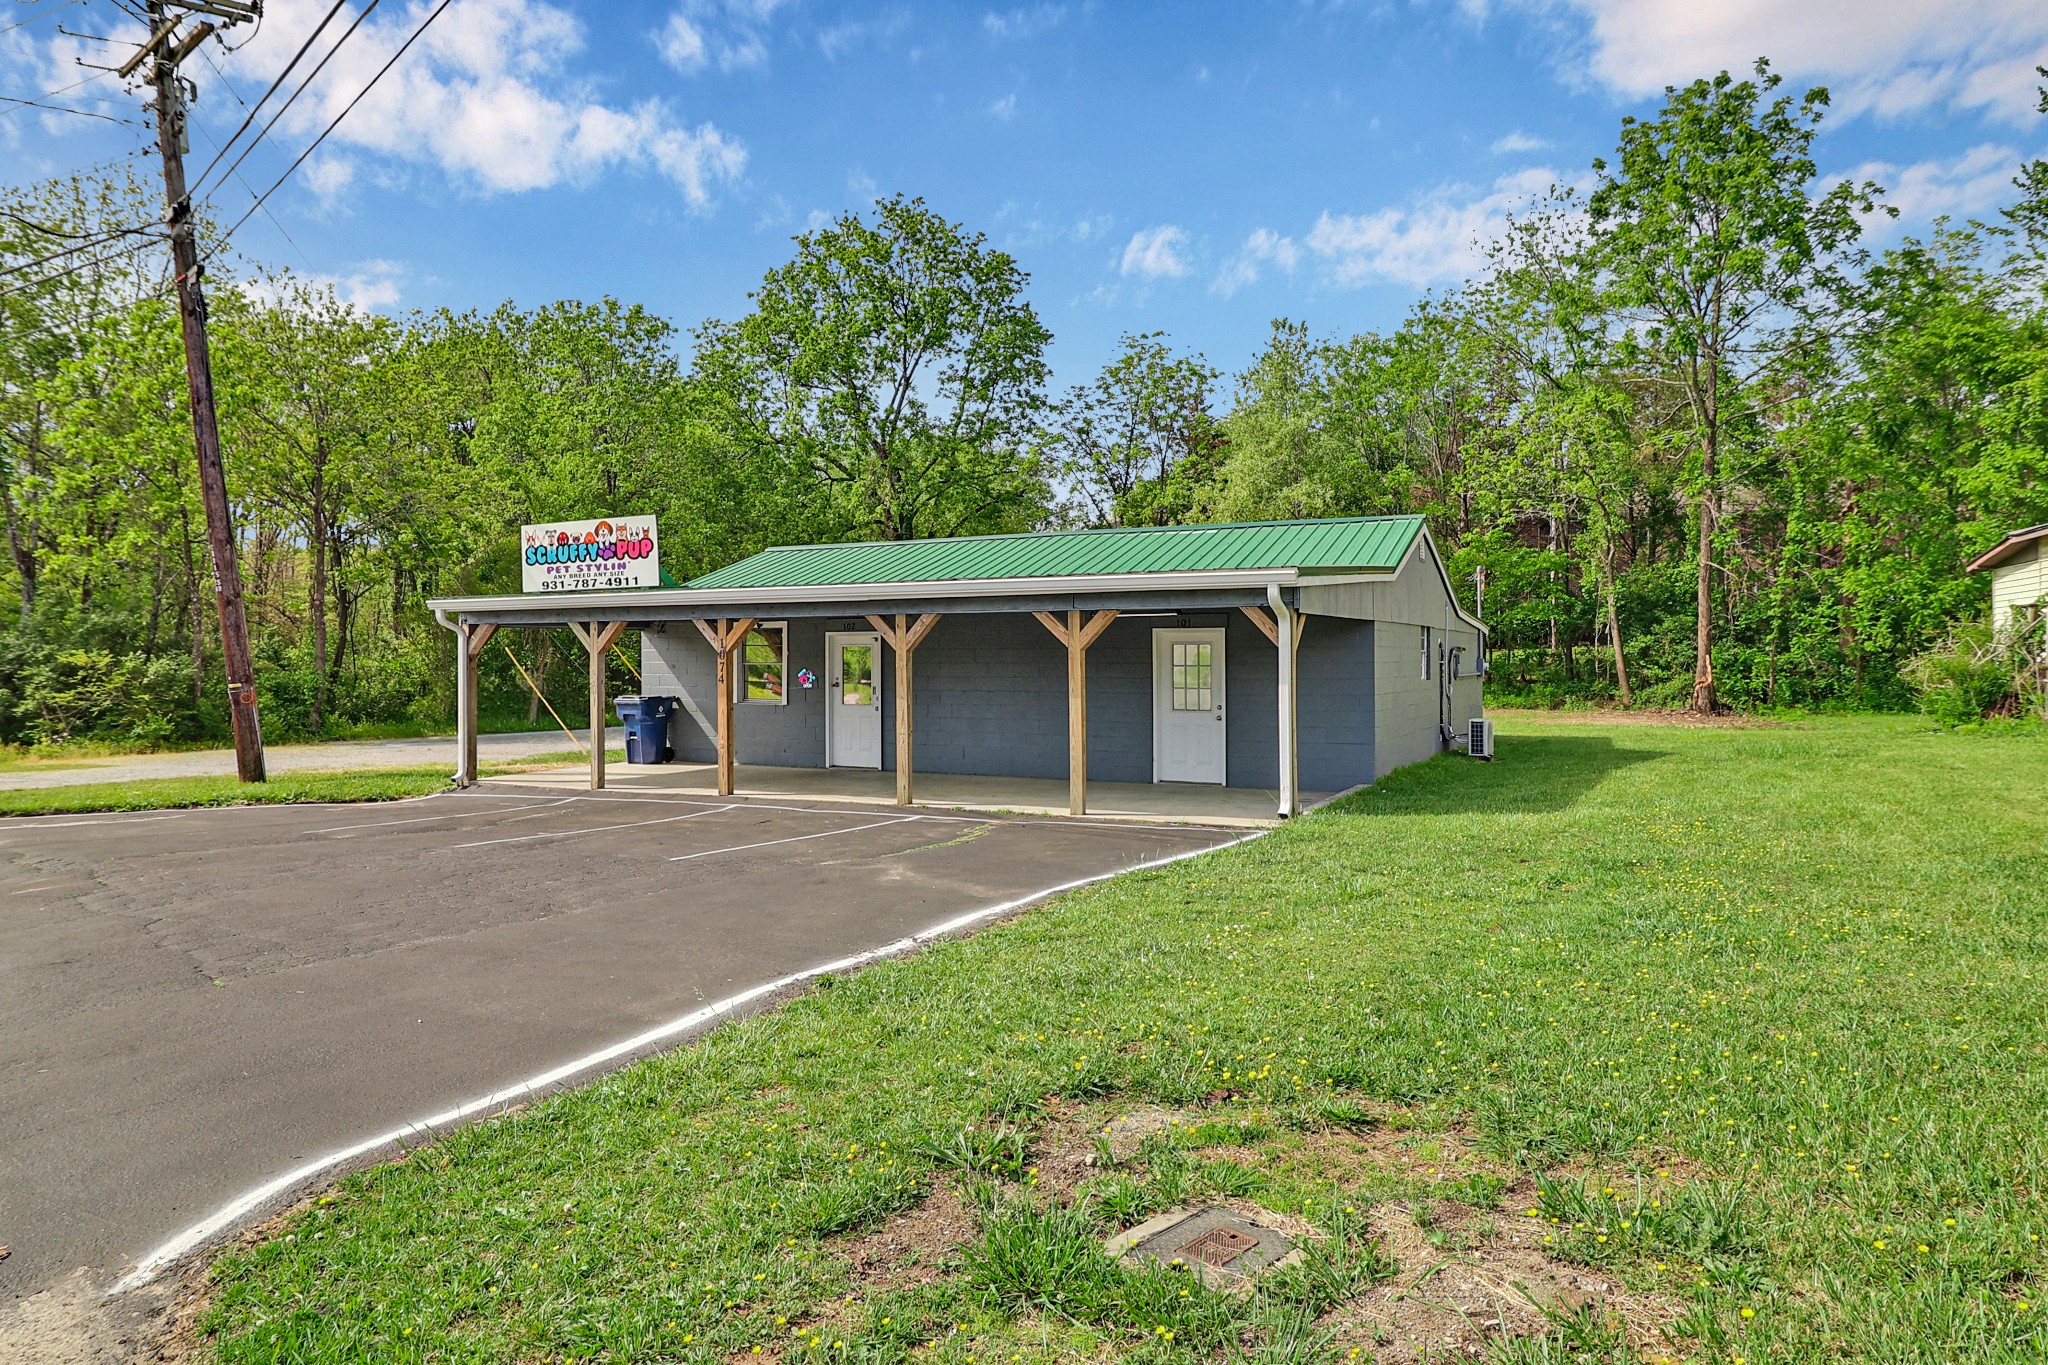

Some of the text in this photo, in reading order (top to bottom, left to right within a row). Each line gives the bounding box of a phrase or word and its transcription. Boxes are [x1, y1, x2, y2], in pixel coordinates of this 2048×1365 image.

[526, 538, 653, 566] SCRUFFY PUP
[546, 566, 571, 574] PET
[542, 577, 639, 590] 931-787-4911
[843, 622, 856, 631] 102
